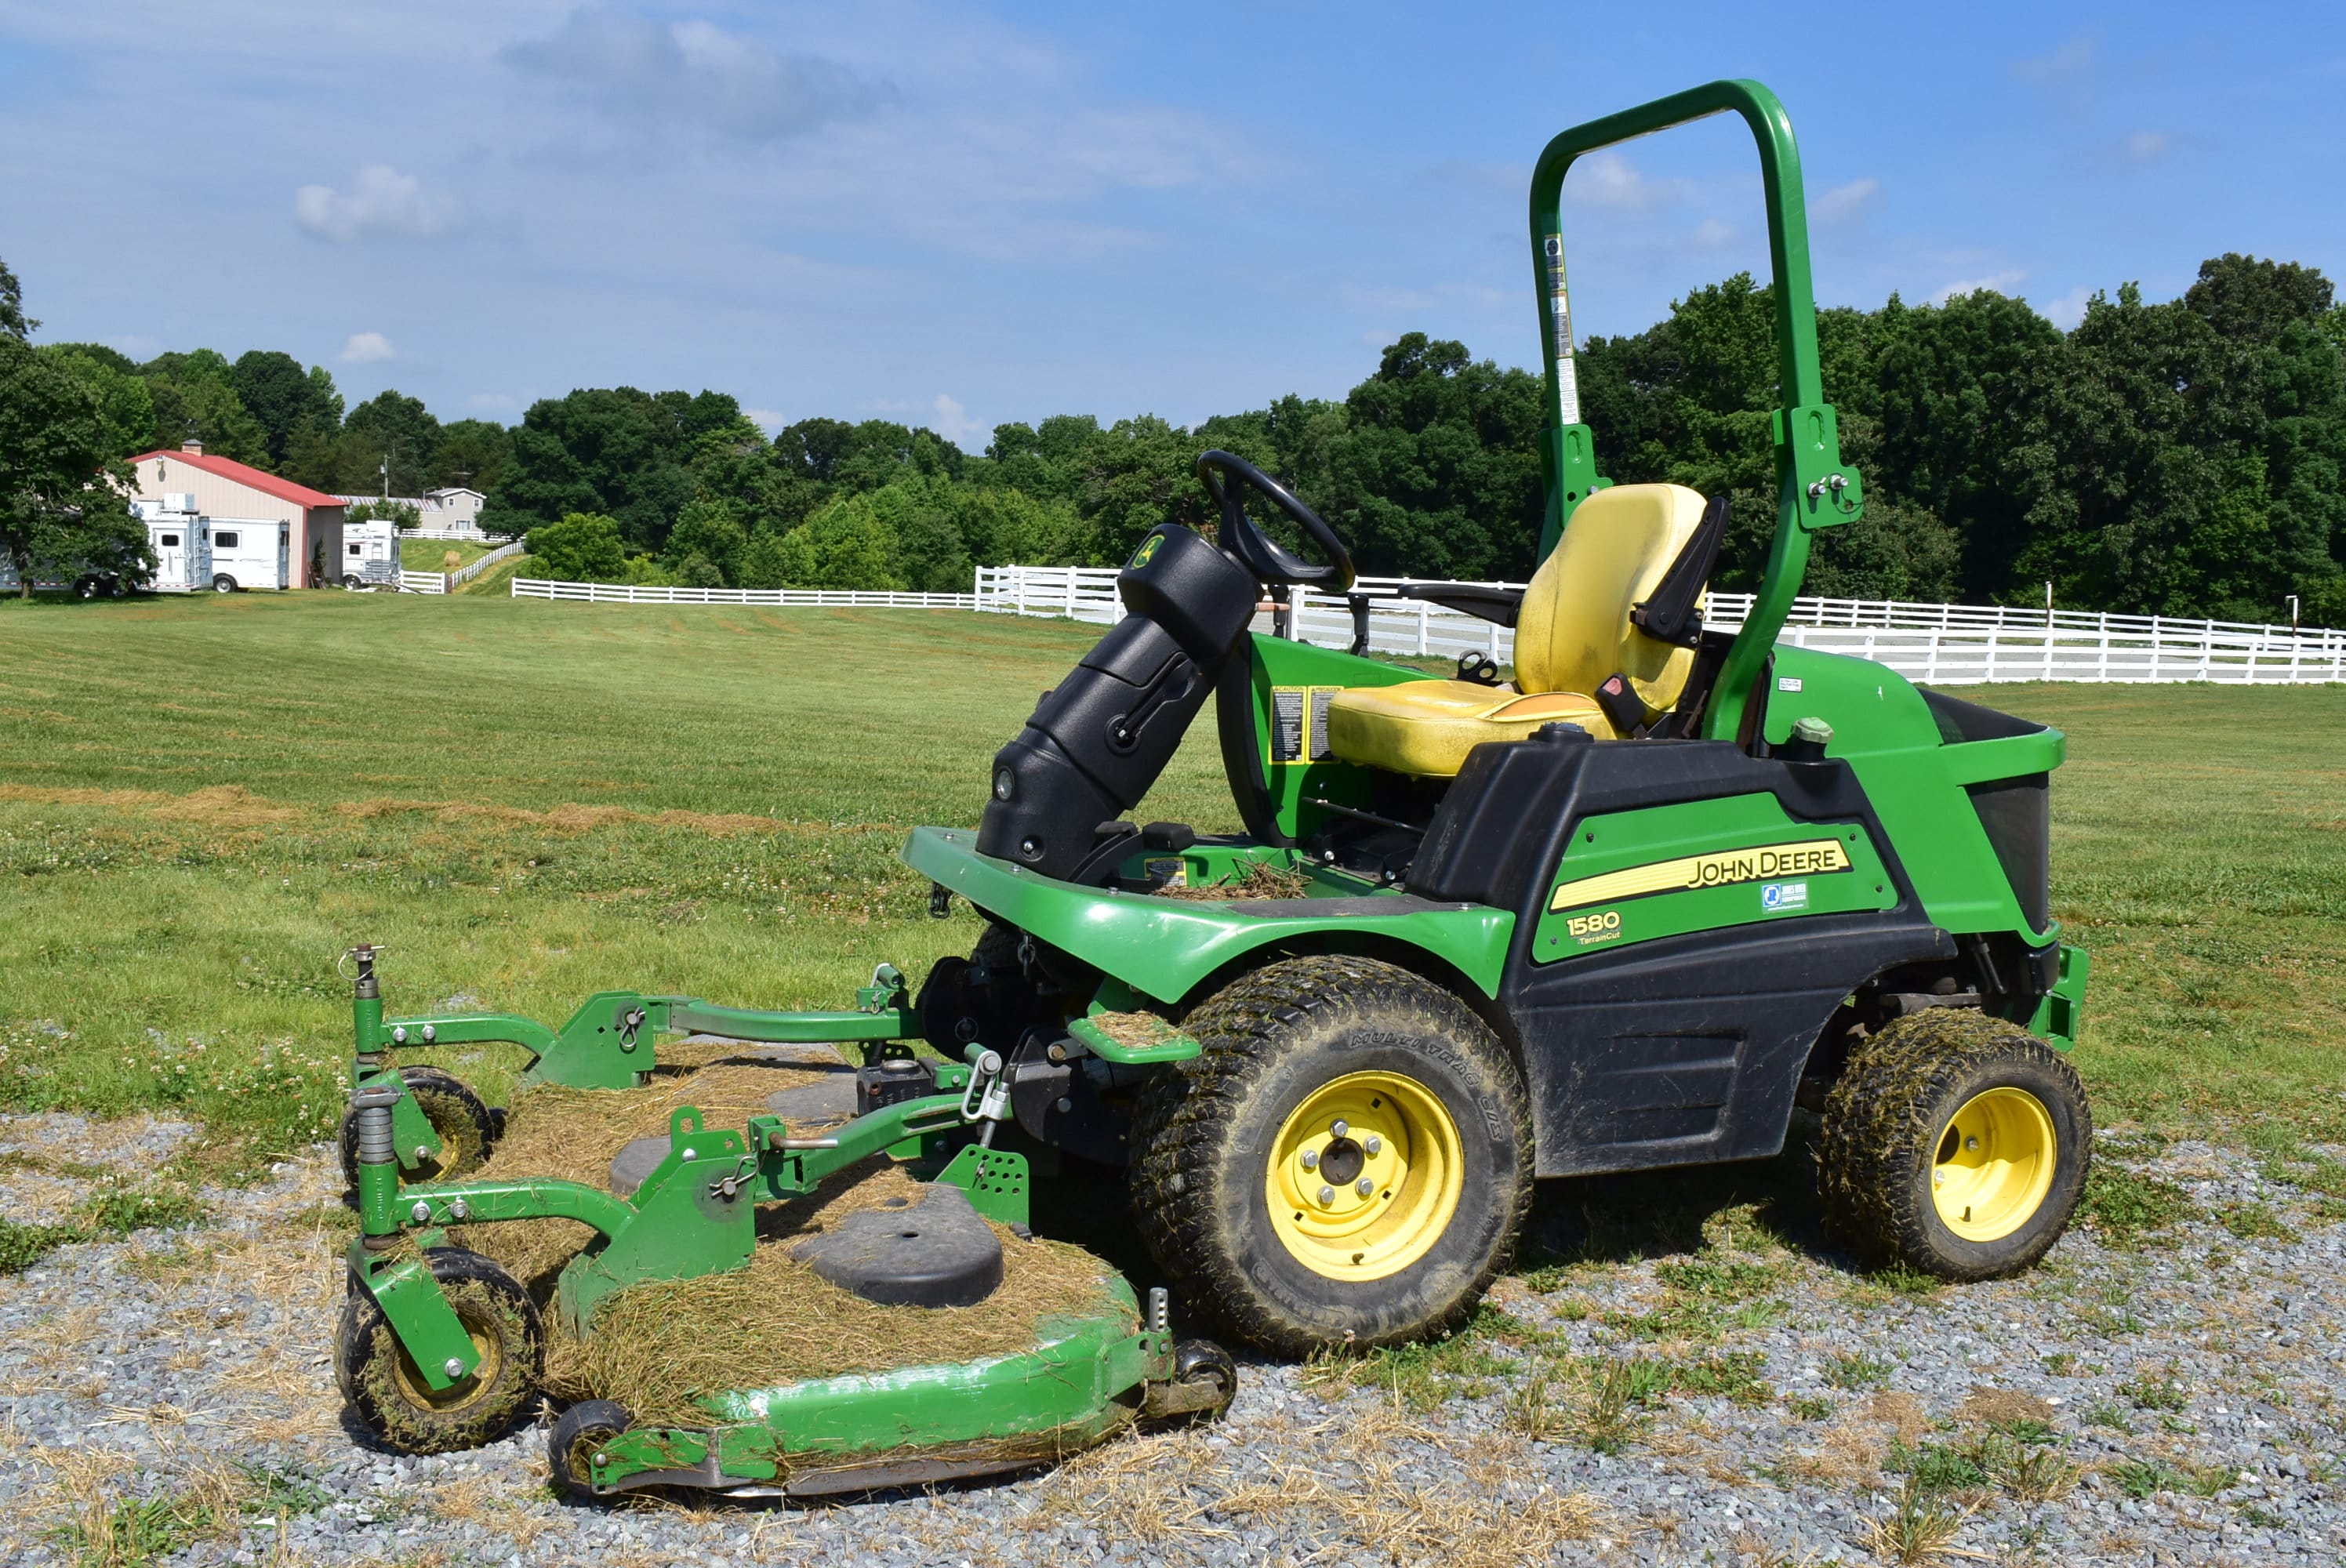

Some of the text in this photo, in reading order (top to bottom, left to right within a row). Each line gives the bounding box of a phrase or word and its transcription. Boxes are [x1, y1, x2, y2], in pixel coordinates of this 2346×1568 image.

[1688, 850, 1836, 884] JOHN DEERE
[1567, 911, 1621, 936] 1580
[1579, 931, 1621, 946] TerrainCut
[1351, 1033, 1422, 1048] MULTI
[1427, 1044, 1480, 1087] TRAC
